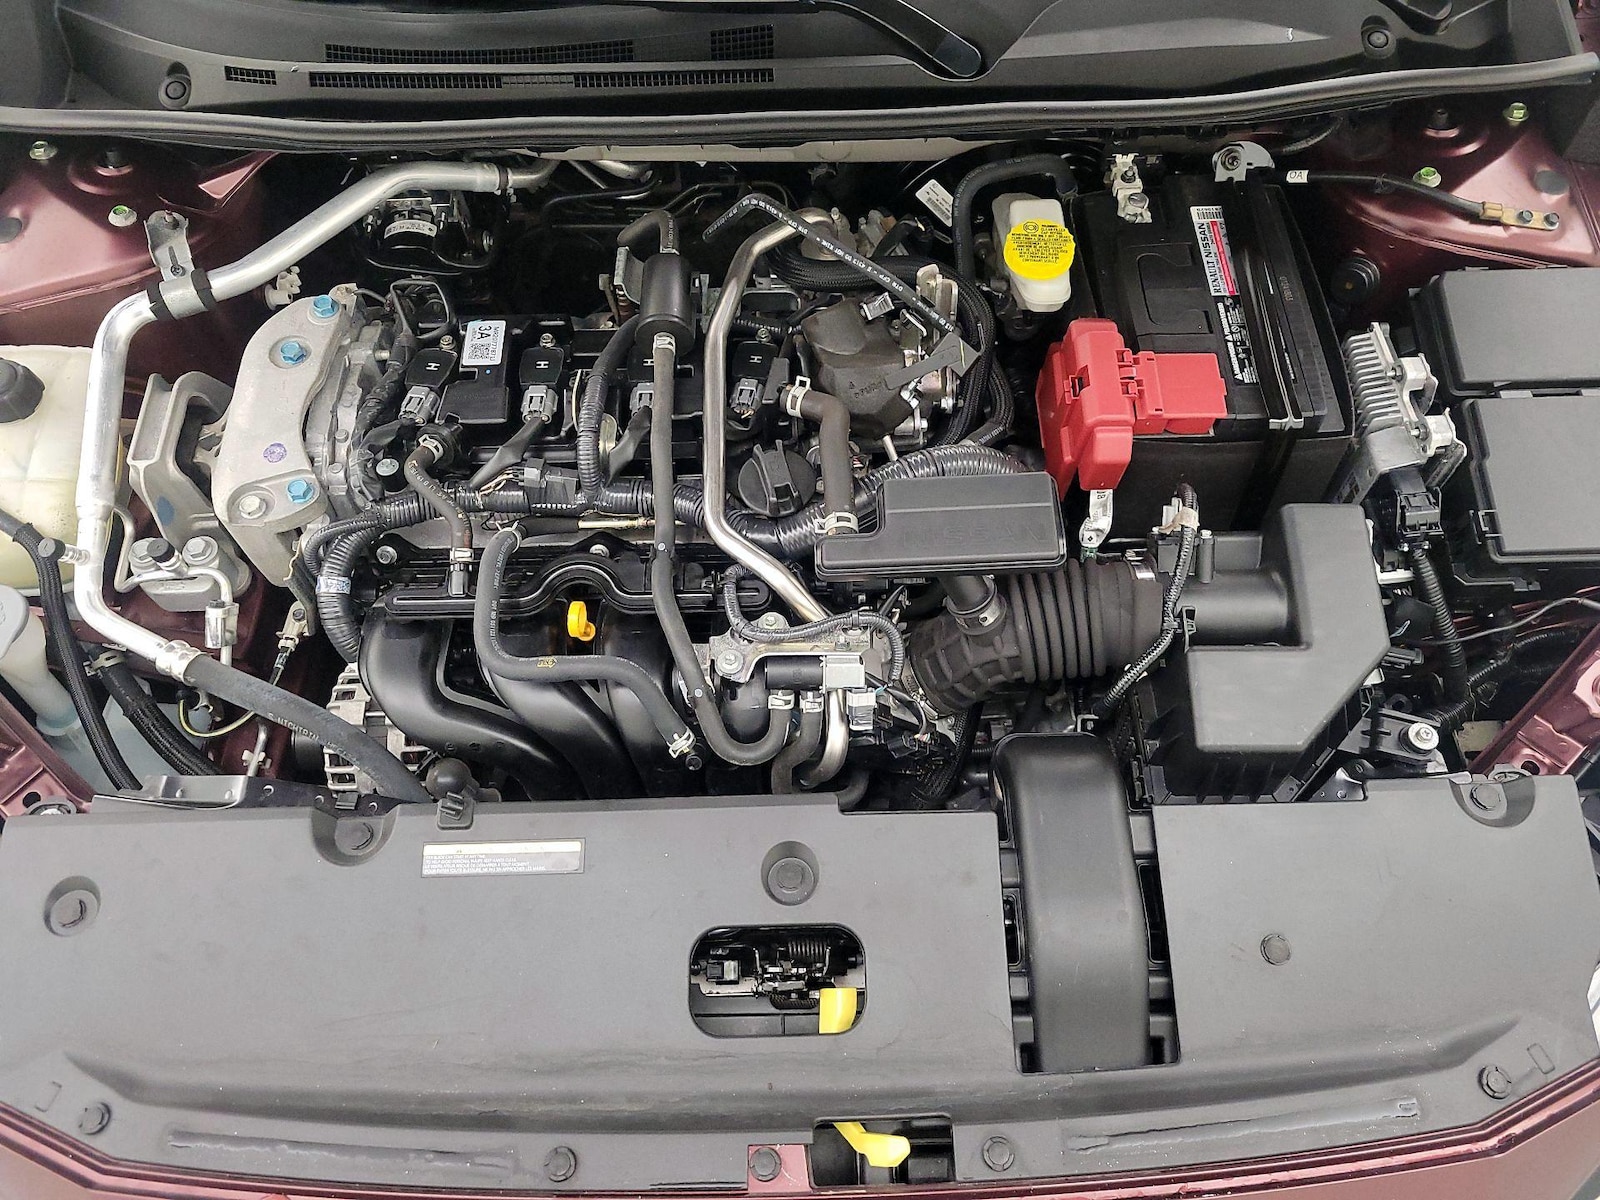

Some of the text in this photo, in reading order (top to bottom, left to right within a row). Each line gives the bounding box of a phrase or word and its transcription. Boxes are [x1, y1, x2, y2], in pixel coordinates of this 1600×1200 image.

[1197, 222, 1213, 258] NISSAN
[1206, 260, 1222, 294] RENAULT
[477, 325, 492, 340] 3A
